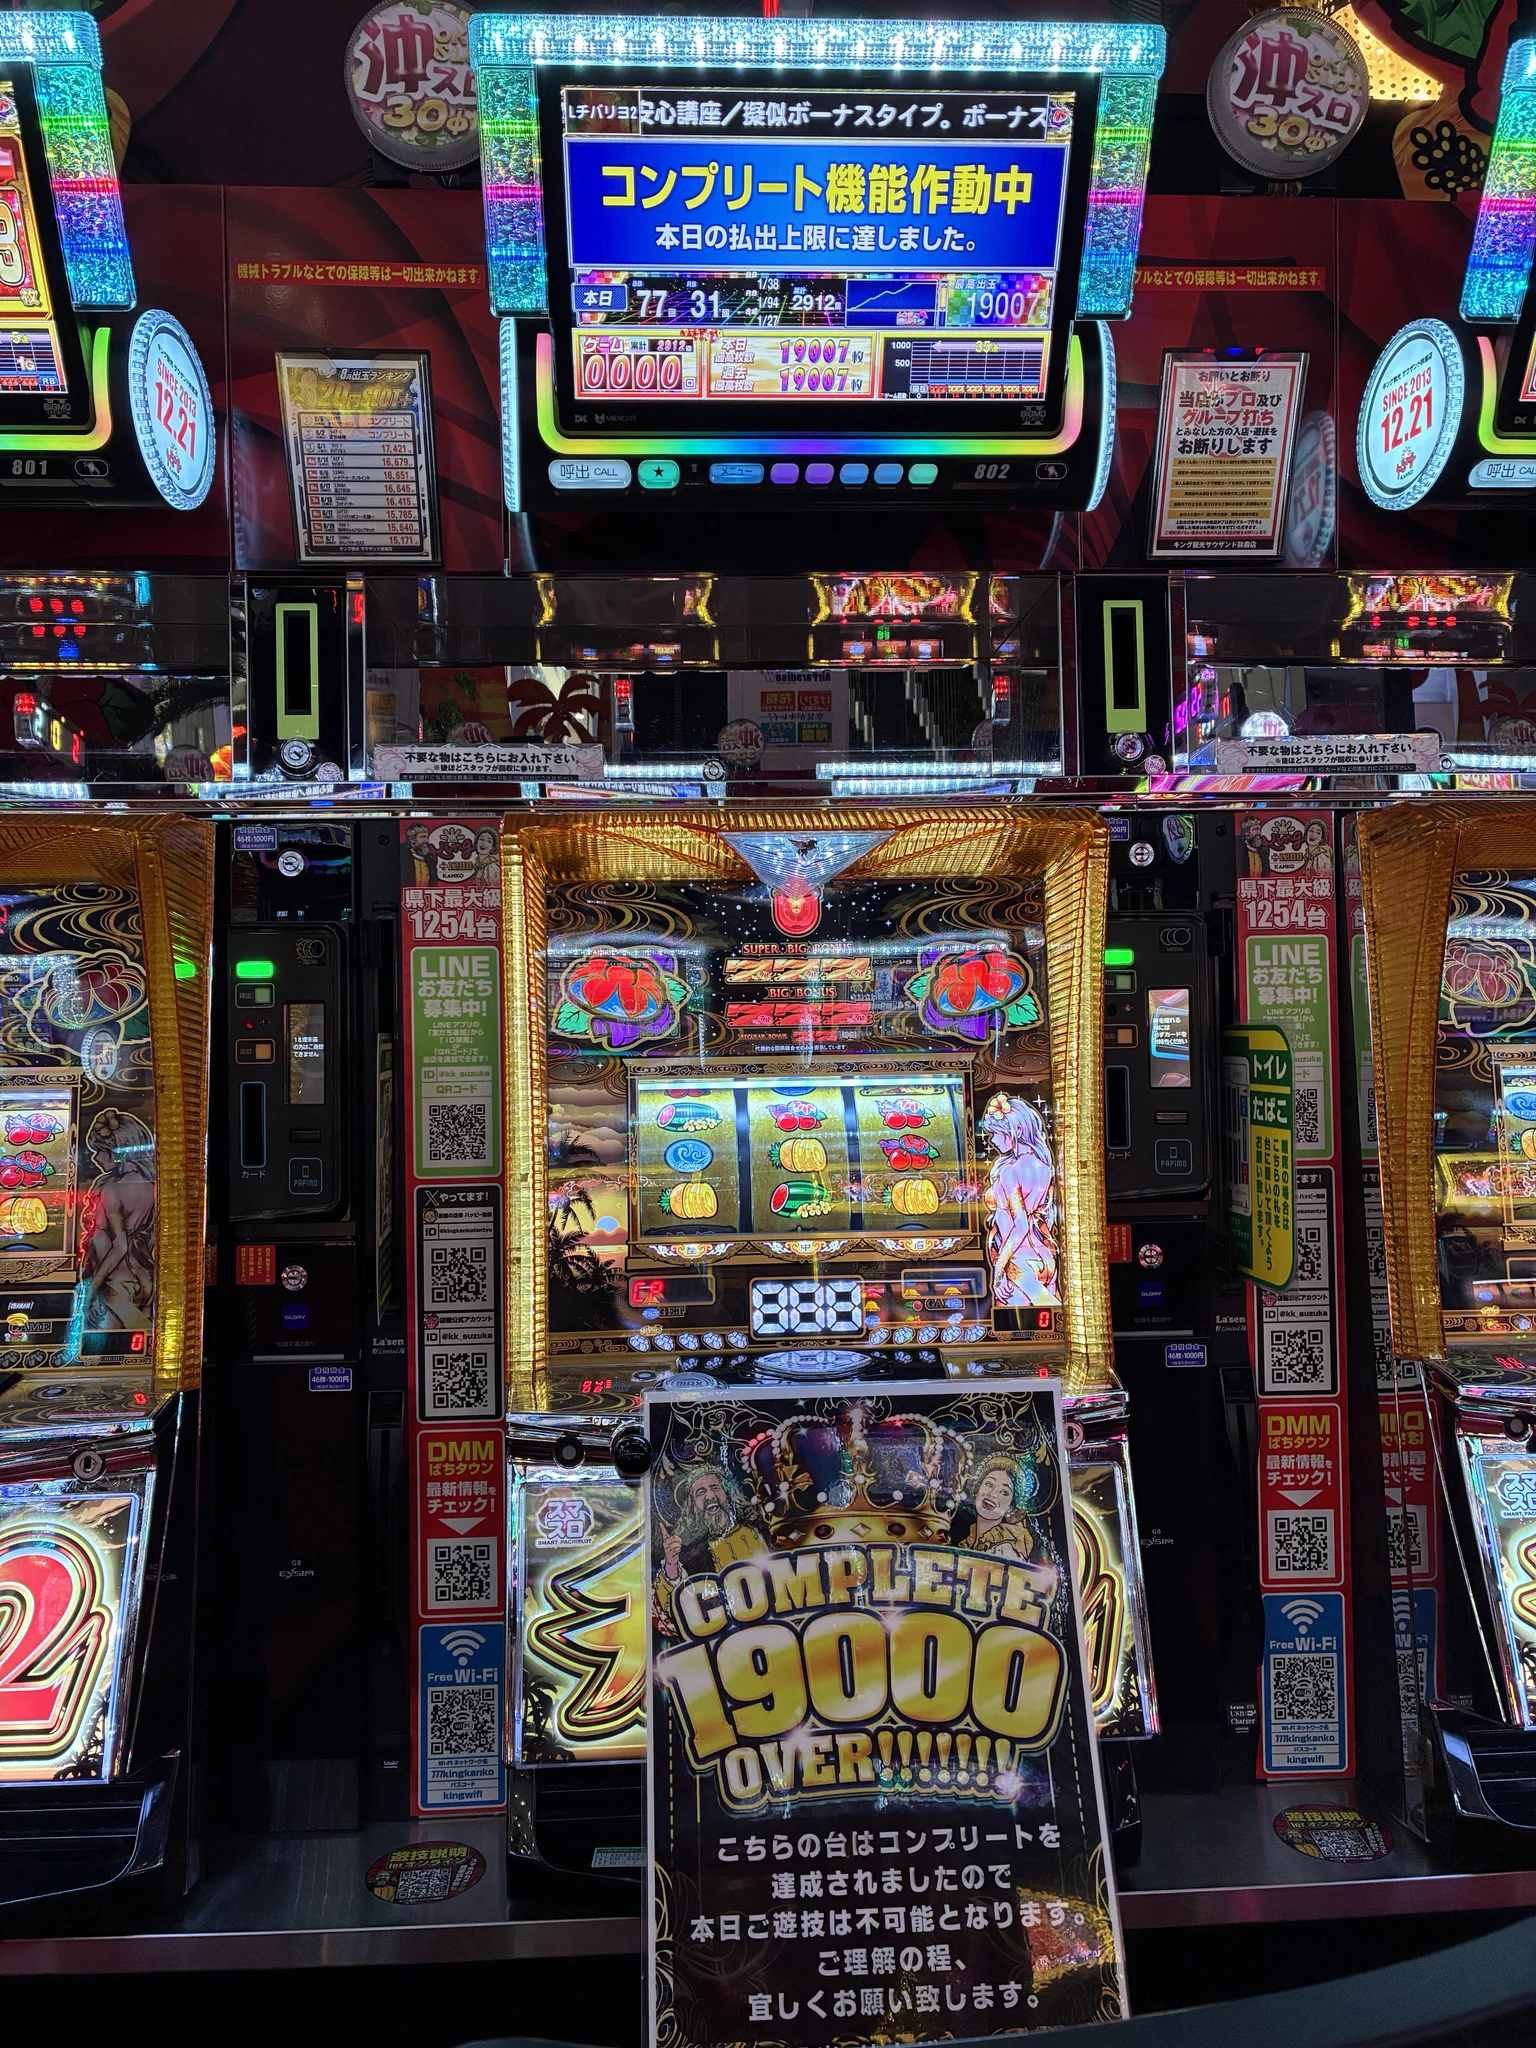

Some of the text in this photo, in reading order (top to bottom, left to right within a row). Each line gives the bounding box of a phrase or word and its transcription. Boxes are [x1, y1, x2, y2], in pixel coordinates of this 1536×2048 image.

[602, 161, 1033, 215] コンプリート機能作動中
[656, 223, 976, 252] 本日の払出上限に達しました。
[757, 278, 779, 290] 1/38
[954, 278, 998, 289] 最高出玉
[583, 290, 612, 306] 本日
[757, 297, 779, 308] 1/94
[584, 336, 624, 353] ゲーム
[722, 338, 747, 351] 本日
[891, 341, 911, 349] 1000
[714, 352, 755, 364] 最高枚数
[895, 359, 910, 367] 500
[722, 366, 747, 380] 過去
[157, 357, 197, 418] SINCE 2013
[714, 380, 755, 392] 最高枚数
[1382, 366, 1432, 412] SINCE 2013
[1179, 389, 1283, 408] 当店がプロ及び
[155, 381, 197, 461] 12.21
[368, 415, 410, 426] コンプリート
[1182, 408, 1274, 427] グループ打ち
[1381, 386, 1433, 454] 12.21
[368, 429, 411, 440] コンプリート
[1177, 438, 1273, 455] お断りします
[12, 459, 48, 475] 801
[560, 464, 618, 479] 呼出 CALL
[721, 467, 753, 476] メニュー
[974, 464, 1010, 480] 802
[1487, 463, 1516, 478] 呼出
[1246, 743, 1417, 757] 不要な物はこちらにお入れ下さい。
[404, 752, 580, 765] 不要な物はこちらにお入れ下さい。
[1240, 878, 1331, 899] 県下最大級
[405, 888, 501, 909] 県下最大級
[1246, 899, 1327, 928] 1254台
[411, 909, 498, 939] 1254台
[743, 943, 779, 954] SUPER
[787, 943, 807, 954] BIG
[1254, 944, 1320, 966] LINE
[420, 956, 490, 978] LINE
[1253, 966, 1322, 985] お友だち
[418, 979, 493, 998] お友だち
[769, 987, 836, 998] BIG BONUS
[423, 1070, 435, 1079] ID
[1253, 1054, 1287, 1085] トイレ
[436, 1084, 478, 1094] QRコード
[1252, 1096, 1288, 1124] たばこ
[1107, 1151, 1131, 1159] カード
[241, 1170, 266, 1179] カード
[1273, 1138, 1281, 1229] こちらの札を
[425, 1228, 437, 1236] ID
[658, 1306, 685, 1316] GET
[1279, 1310, 1328, 1318] @kk_suzuka
[426, 1332, 493, 1341] ID @kk_suzuka
[1267, 1415, 1330, 1435] DMM
[427, 1440, 494, 1462] DMM
[1266, 1454, 1333, 1470] 最新情報を
[426, 1481, 497, 1497] 最新情報を
[672, 1542, 1058, 1640] COMPLETE
[1269, 1636, 1337, 1651] Free Wi-Fi
[427, 1668, 498, 1684] Free Wi-Fi
[660, 1608, 1066, 1758] 19000
[1286, 1755, 1325, 1764] kingwifi
[443, 1790, 483, 1800] kingwifi
[717, 1822, 1061, 1863] こちらの台はコンプリートを
[771, 1863, 1012, 1901] 達成されましたので
[689, 1900, 1085, 1944] 本日ご遊技は不可能となります。
[817, 1943, 969, 1976] ご理解の程、
[748, 1980, 1040, 2023] 宜しくお願い致します。
